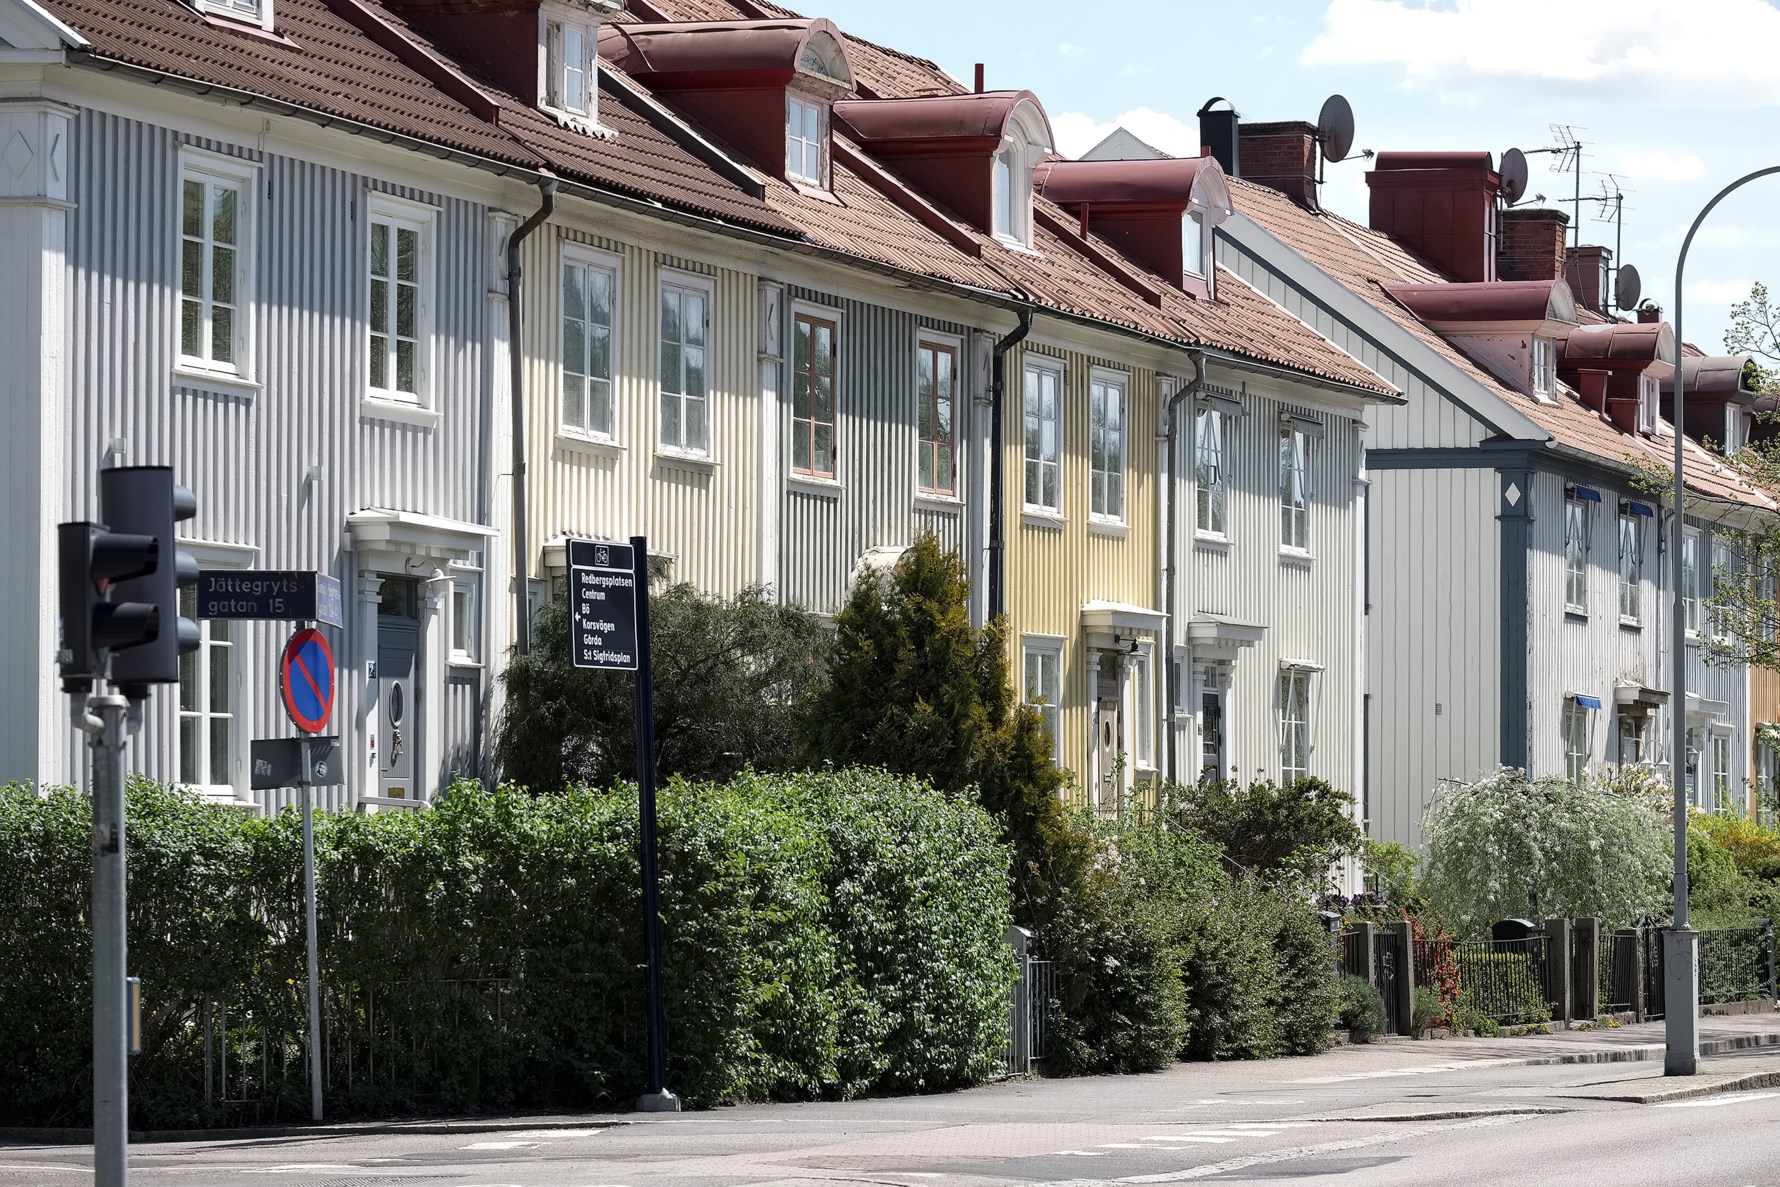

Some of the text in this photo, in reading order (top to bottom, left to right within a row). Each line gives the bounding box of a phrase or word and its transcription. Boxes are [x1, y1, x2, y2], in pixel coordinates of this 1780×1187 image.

[208, 577, 304, 595] Jättegryts-
[581, 572, 633, 588] Redbergsplatsen
[581, 588, 606, 600] Centrum
[208, 599, 285, 615] gatan 15
[581, 603, 590, 614] Bö
[582, 618, 615, 633] Korsvägen
[583, 633, 602, 646] Gårda
[593, 650, 631, 664] Sigfridsplan
